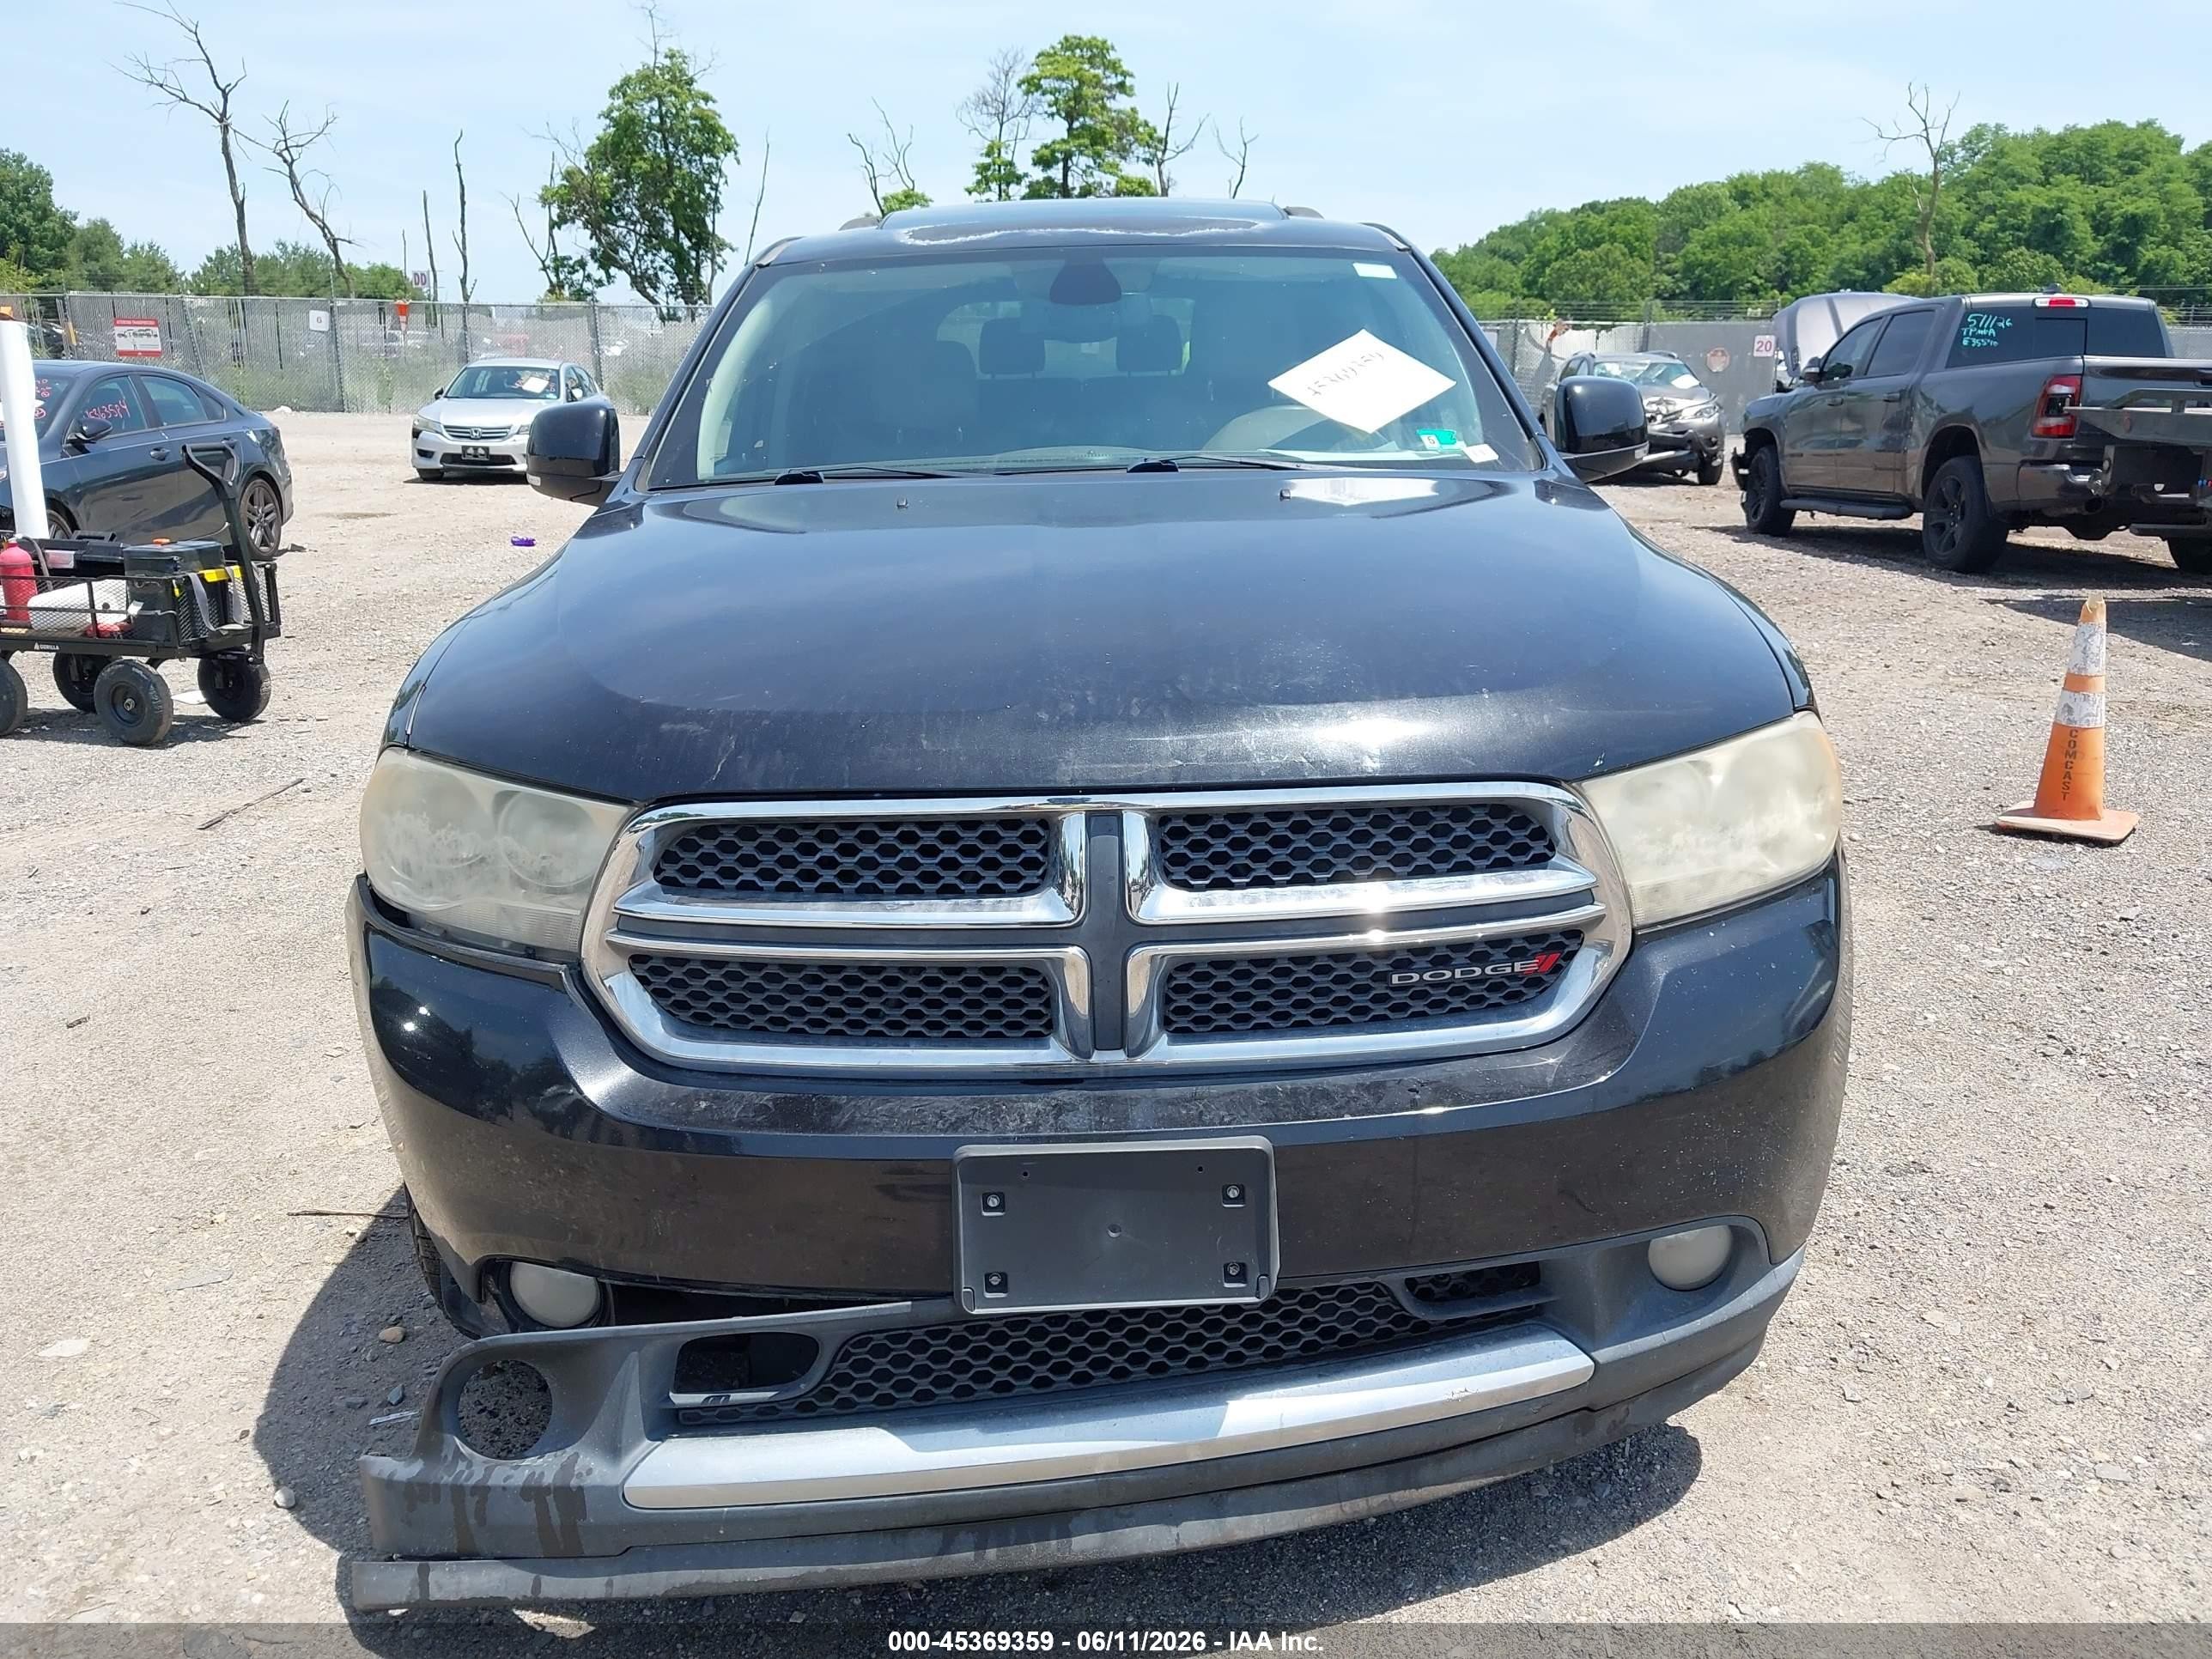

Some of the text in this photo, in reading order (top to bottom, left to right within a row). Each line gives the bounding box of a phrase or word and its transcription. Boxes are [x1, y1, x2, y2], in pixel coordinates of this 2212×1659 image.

[1755, 340, 1772, 352] 20
[2061, 729, 2079, 801] COMCAST
[1391, 959, 1540, 985] DODGE
